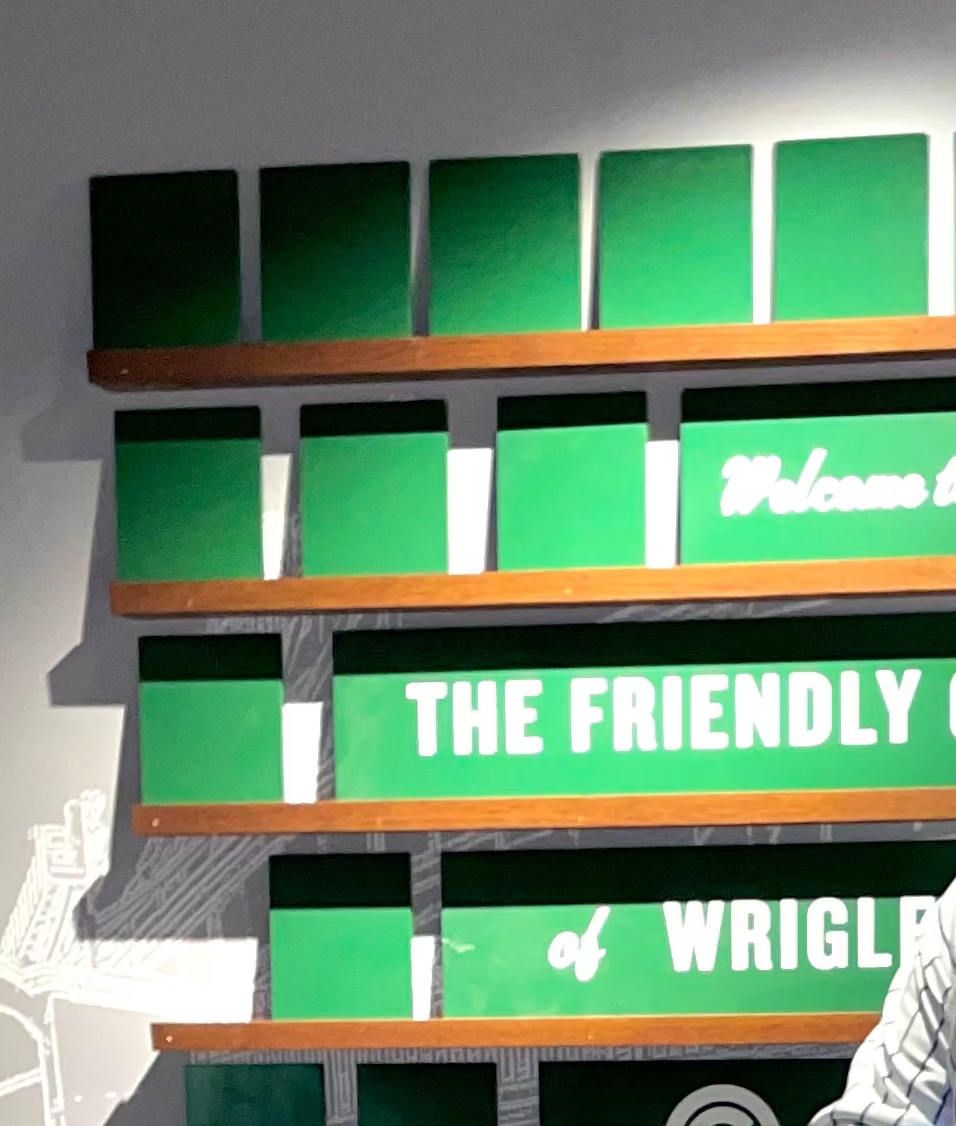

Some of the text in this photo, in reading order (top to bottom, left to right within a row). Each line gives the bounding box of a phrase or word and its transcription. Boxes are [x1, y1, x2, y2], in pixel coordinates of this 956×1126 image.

[720, 447, 929, 516] Welcome
[405, 680, 544, 757] THE
[570, 668, 922, 754] FRIENDLY
[547, 905, 609, 982] of
